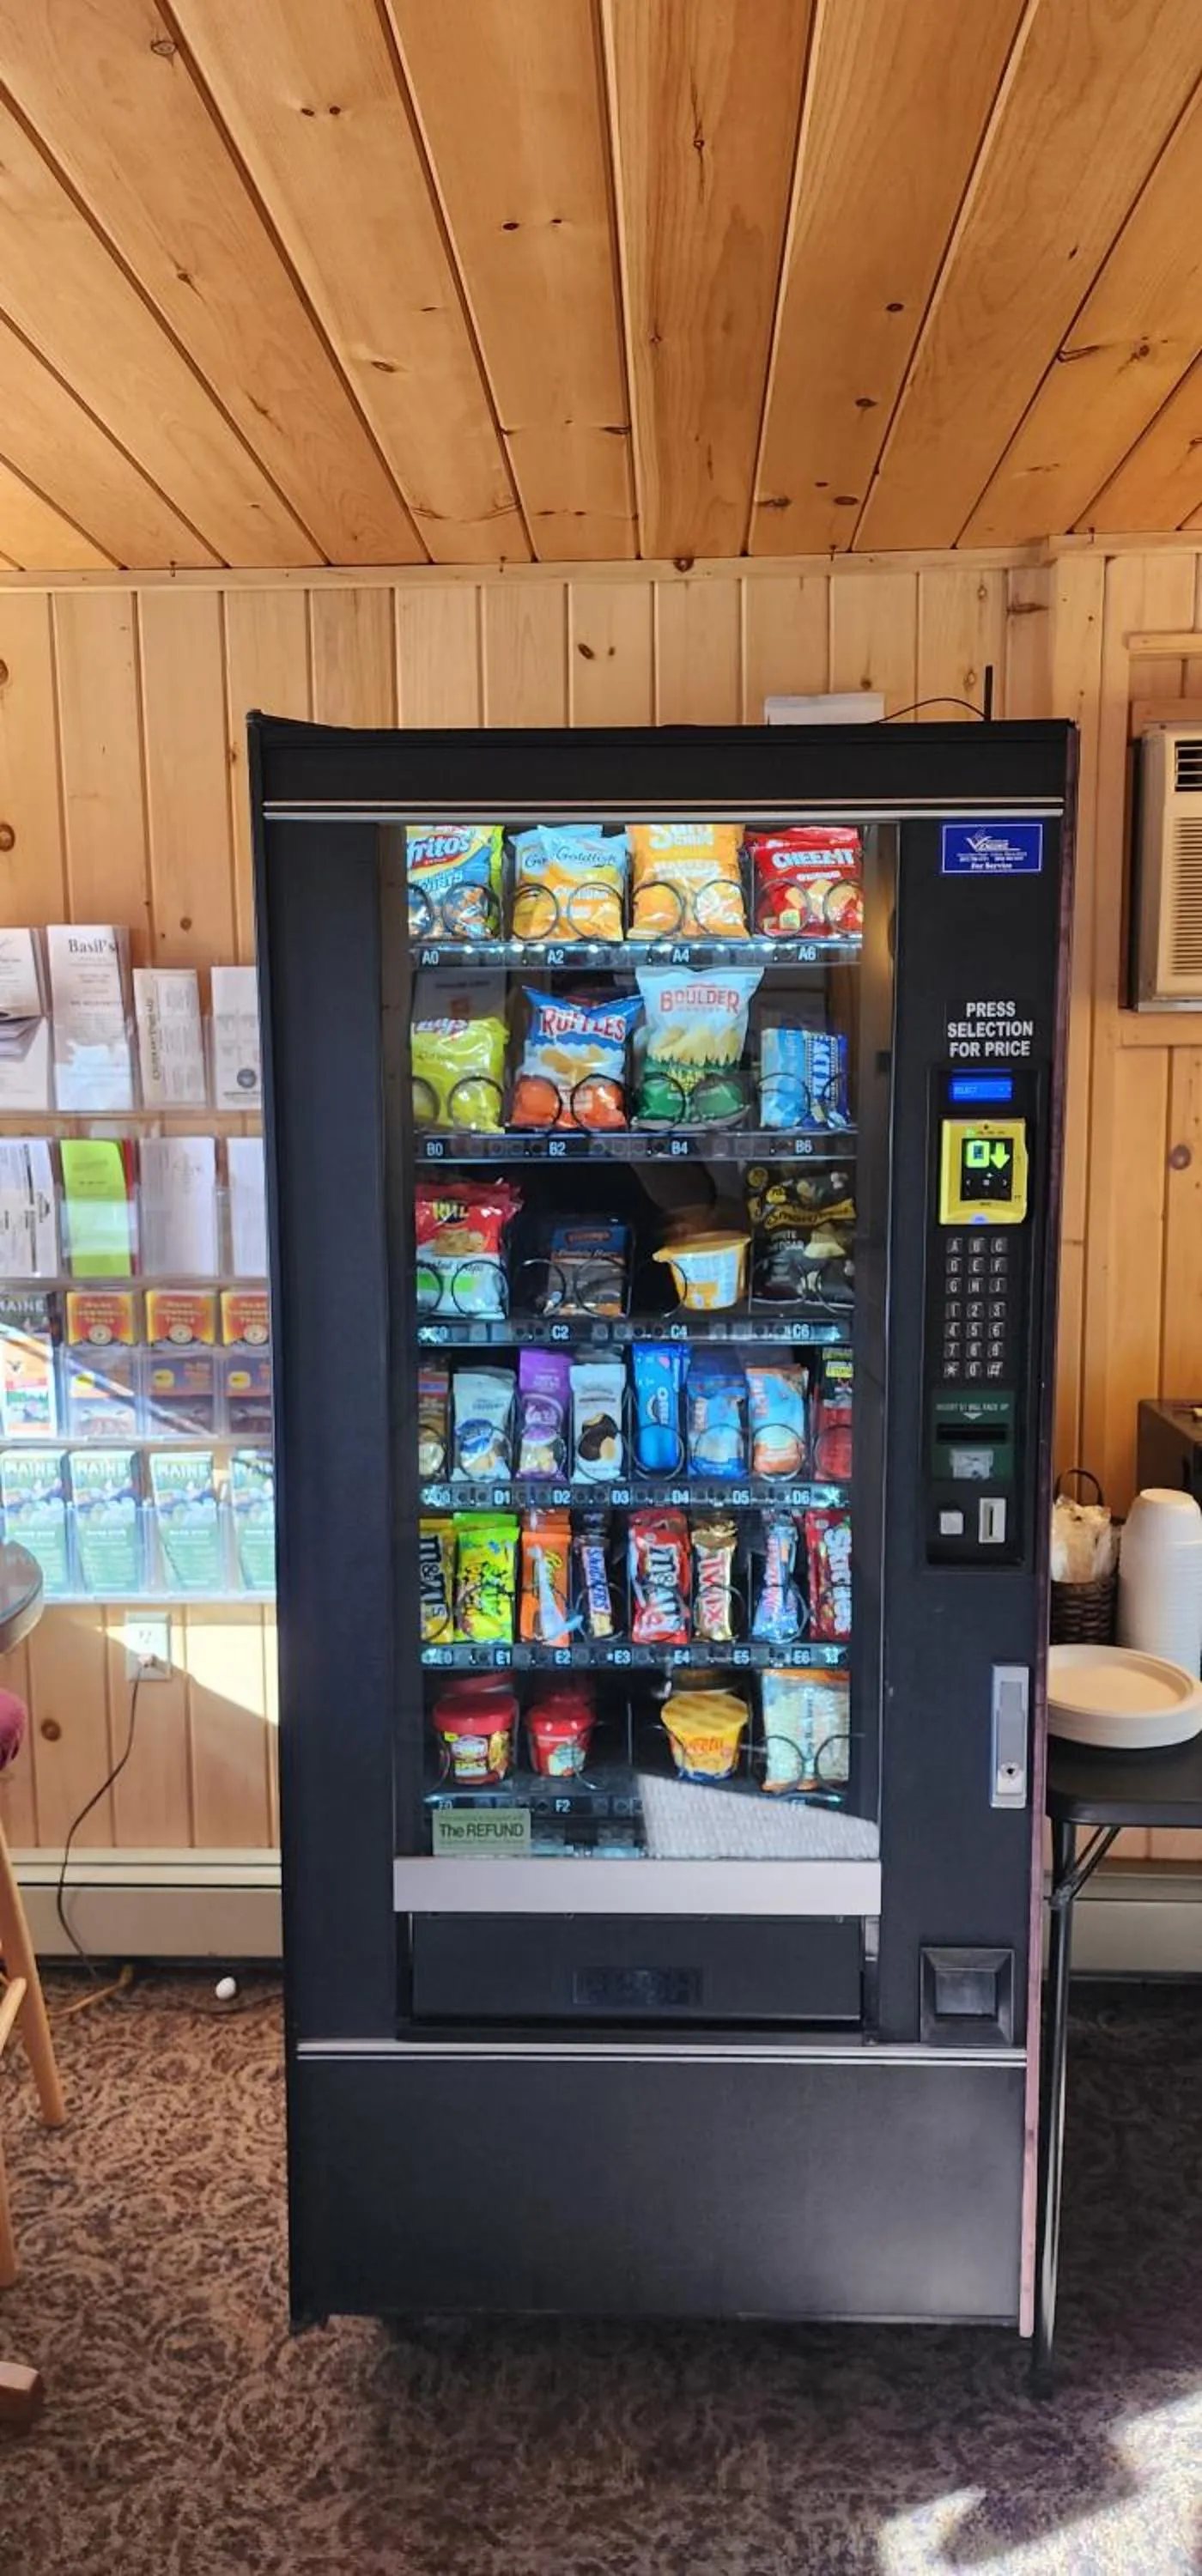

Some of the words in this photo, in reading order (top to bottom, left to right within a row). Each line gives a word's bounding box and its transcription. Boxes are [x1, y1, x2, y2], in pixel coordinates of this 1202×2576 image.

[68, 939, 117, 953] Basil's
[422, 951, 439, 964] A0
[547, 950, 564, 963] A2
[672, 948, 690, 963] A4
[798, 946, 816, 961] A6
[660, 988, 740, 1015] BOULDER
[966, 1000, 1016, 1018] PRESS
[541, 1005, 627, 1042] RUFFLES
[947, 1021, 1034, 1038] SELECTION
[949, 1042, 980, 1058] FOR
[985, 1040, 1030, 1057] PRICE
[426, 1142, 443, 1156] B0
[549, 1141, 566, 1156] B2
[671, 1141, 688, 1155] B4
[795, 1140, 812, 1153] B6
[552, 1325, 569, 1340] C2
[671, 1325, 688, 1339] C4
[792, 1324, 810, 1338] C6
[494, 1490, 510, 1504] D1
[554, 1490, 571, 1504] D2
[612, 1491, 629, 1504] D3
[672, 1490, 689, 1504] D4
[732, 1490, 750, 1504] D5
[792, 1491, 810, 1504] D6
[699, 1552, 726, 1626] TWIX
[495, 1651, 511, 1664] E1
[555, 1650, 571, 1664] E2
[615, 1651, 631, 1664] E3
[674, 1649, 690, 1663] E4
[734, 1649, 750, 1663] E5
[794, 1650, 810, 1664] E6
[555, 1800, 571, 1813] F2
[439, 1823, 464, 1838] The
[466, 1823, 525, 1838] REFUND
